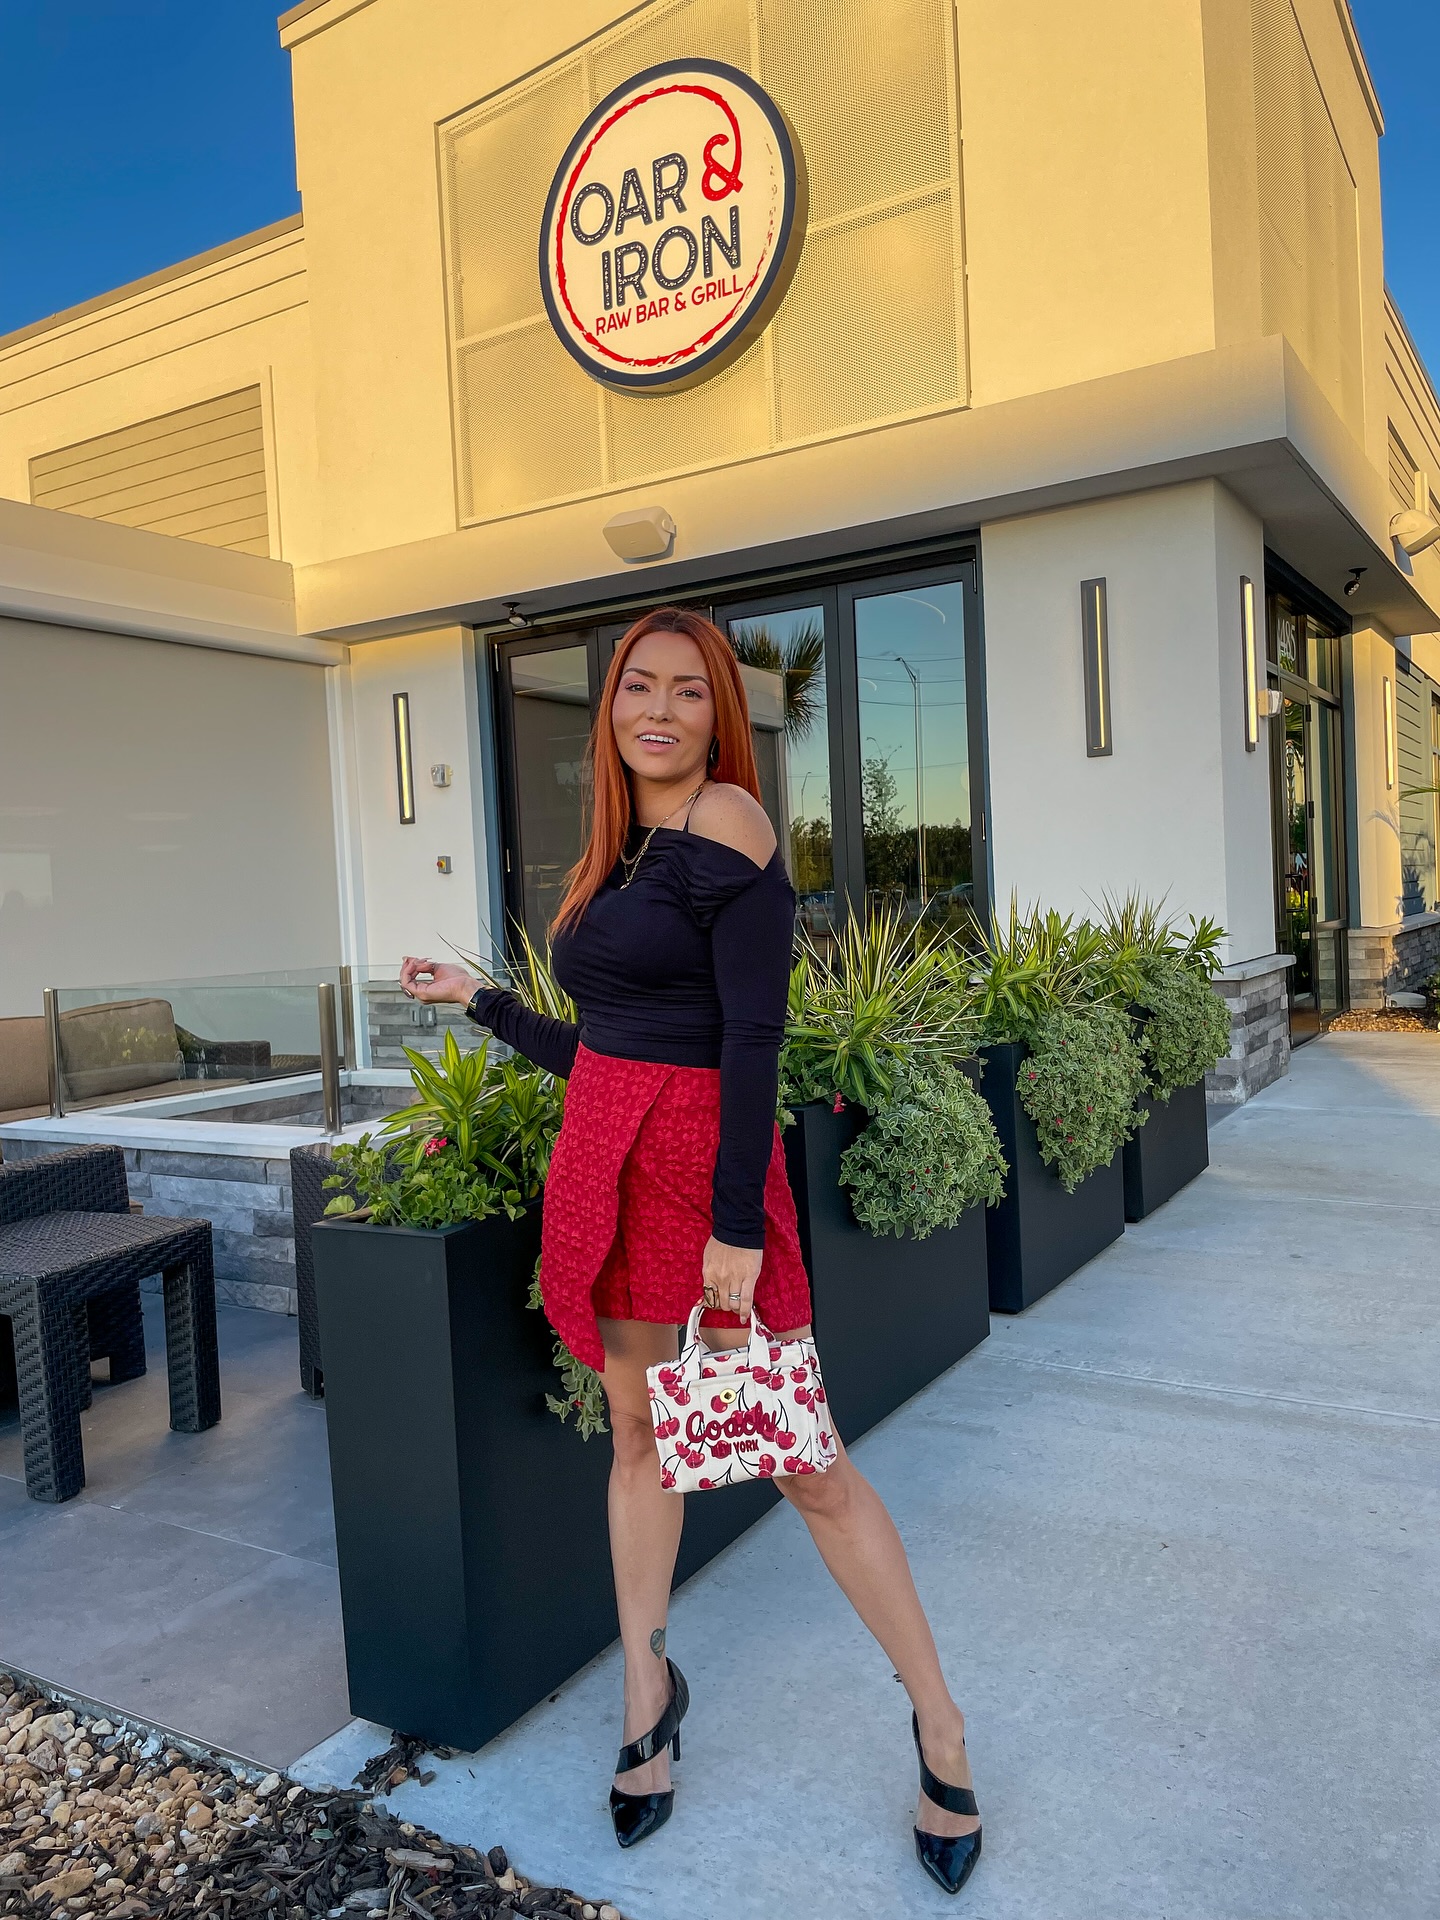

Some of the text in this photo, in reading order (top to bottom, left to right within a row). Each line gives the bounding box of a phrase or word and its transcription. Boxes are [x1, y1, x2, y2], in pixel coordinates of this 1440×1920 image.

[570, 133, 743, 246] OAR &
[601, 205, 741, 310] IRON
[595, 274, 743, 336] RAW BAR & GRILL
[685, 1400, 778, 1443] Coach
[733, 1439, 760, 1453] YORK
